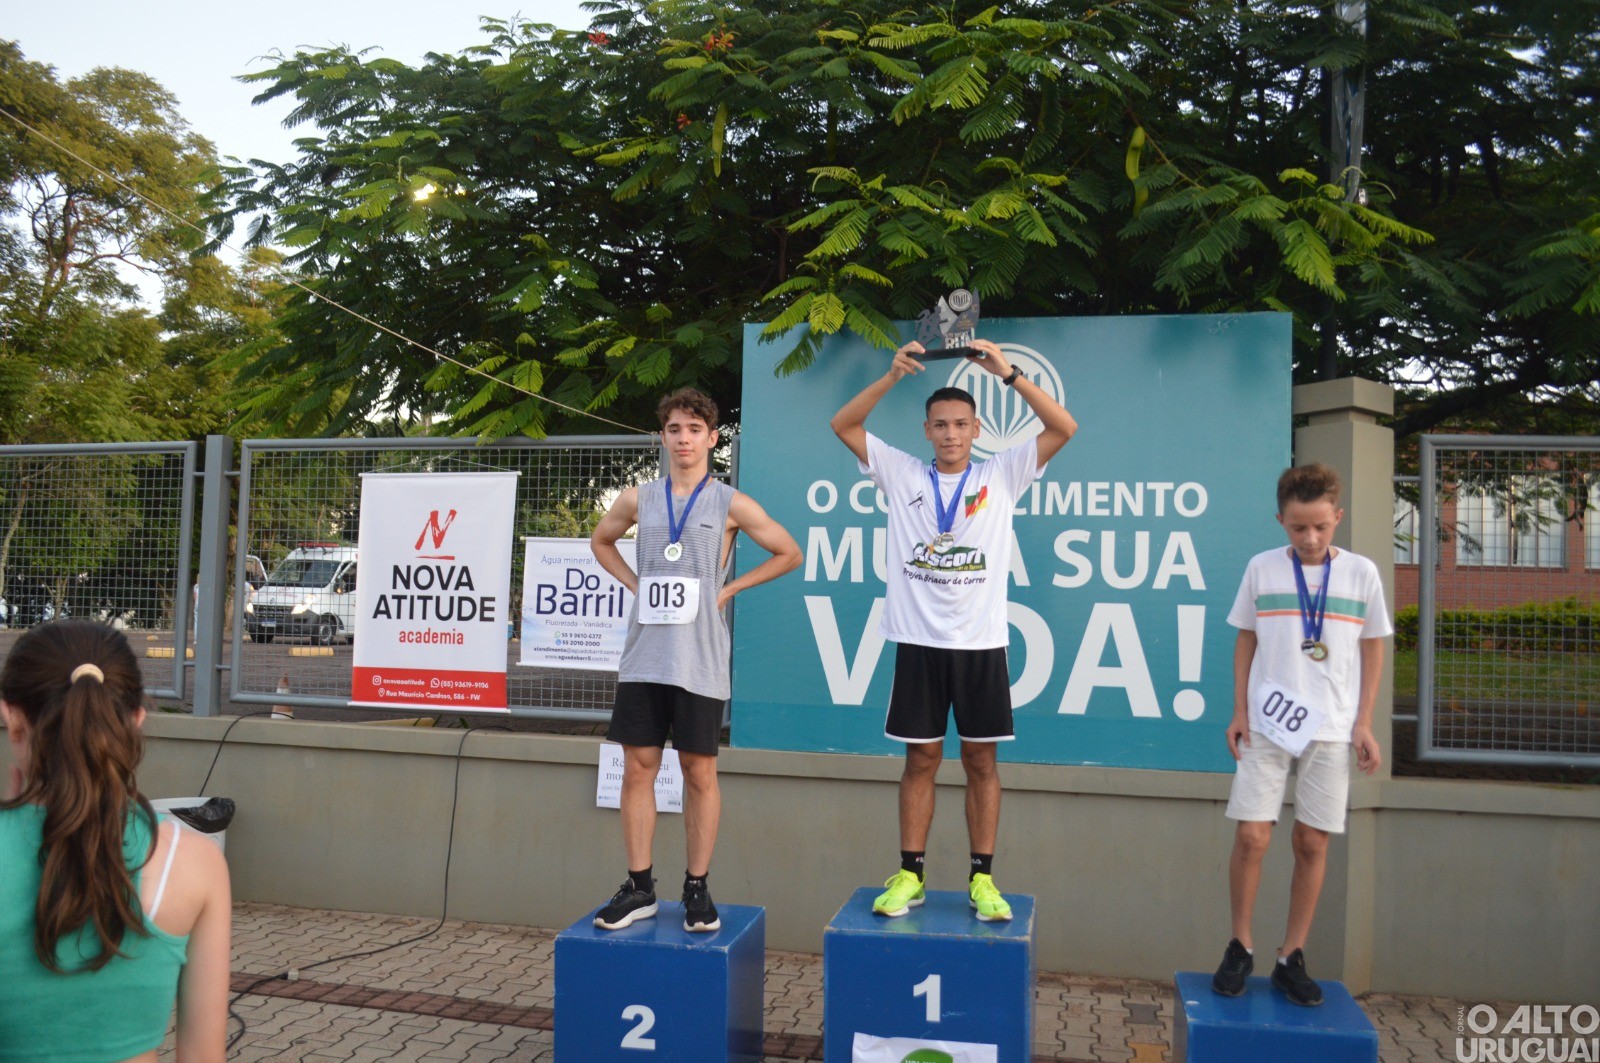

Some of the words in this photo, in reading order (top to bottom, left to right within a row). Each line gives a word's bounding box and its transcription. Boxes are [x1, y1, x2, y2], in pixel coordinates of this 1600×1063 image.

[807, 480, 838, 514] O
[540, 554, 562, 565] Água
[564, 556, 592, 564] mineral
[1052, 529, 1206, 590] SUA
[392, 565, 474, 591] NOVA
[565, 568, 600, 591] Do
[952, 577, 961, 585] de
[964, 576, 986, 585] Correr
[372, 594, 496, 622] ATITUDE
[536, 584, 624, 617] Barril
[649, 582, 685, 608] 013
[399, 628, 464, 645] academia
[1262, 690, 1308, 732] 018
[912, 973, 941, 1023] 1
[620, 1004, 656, 1050] 2
